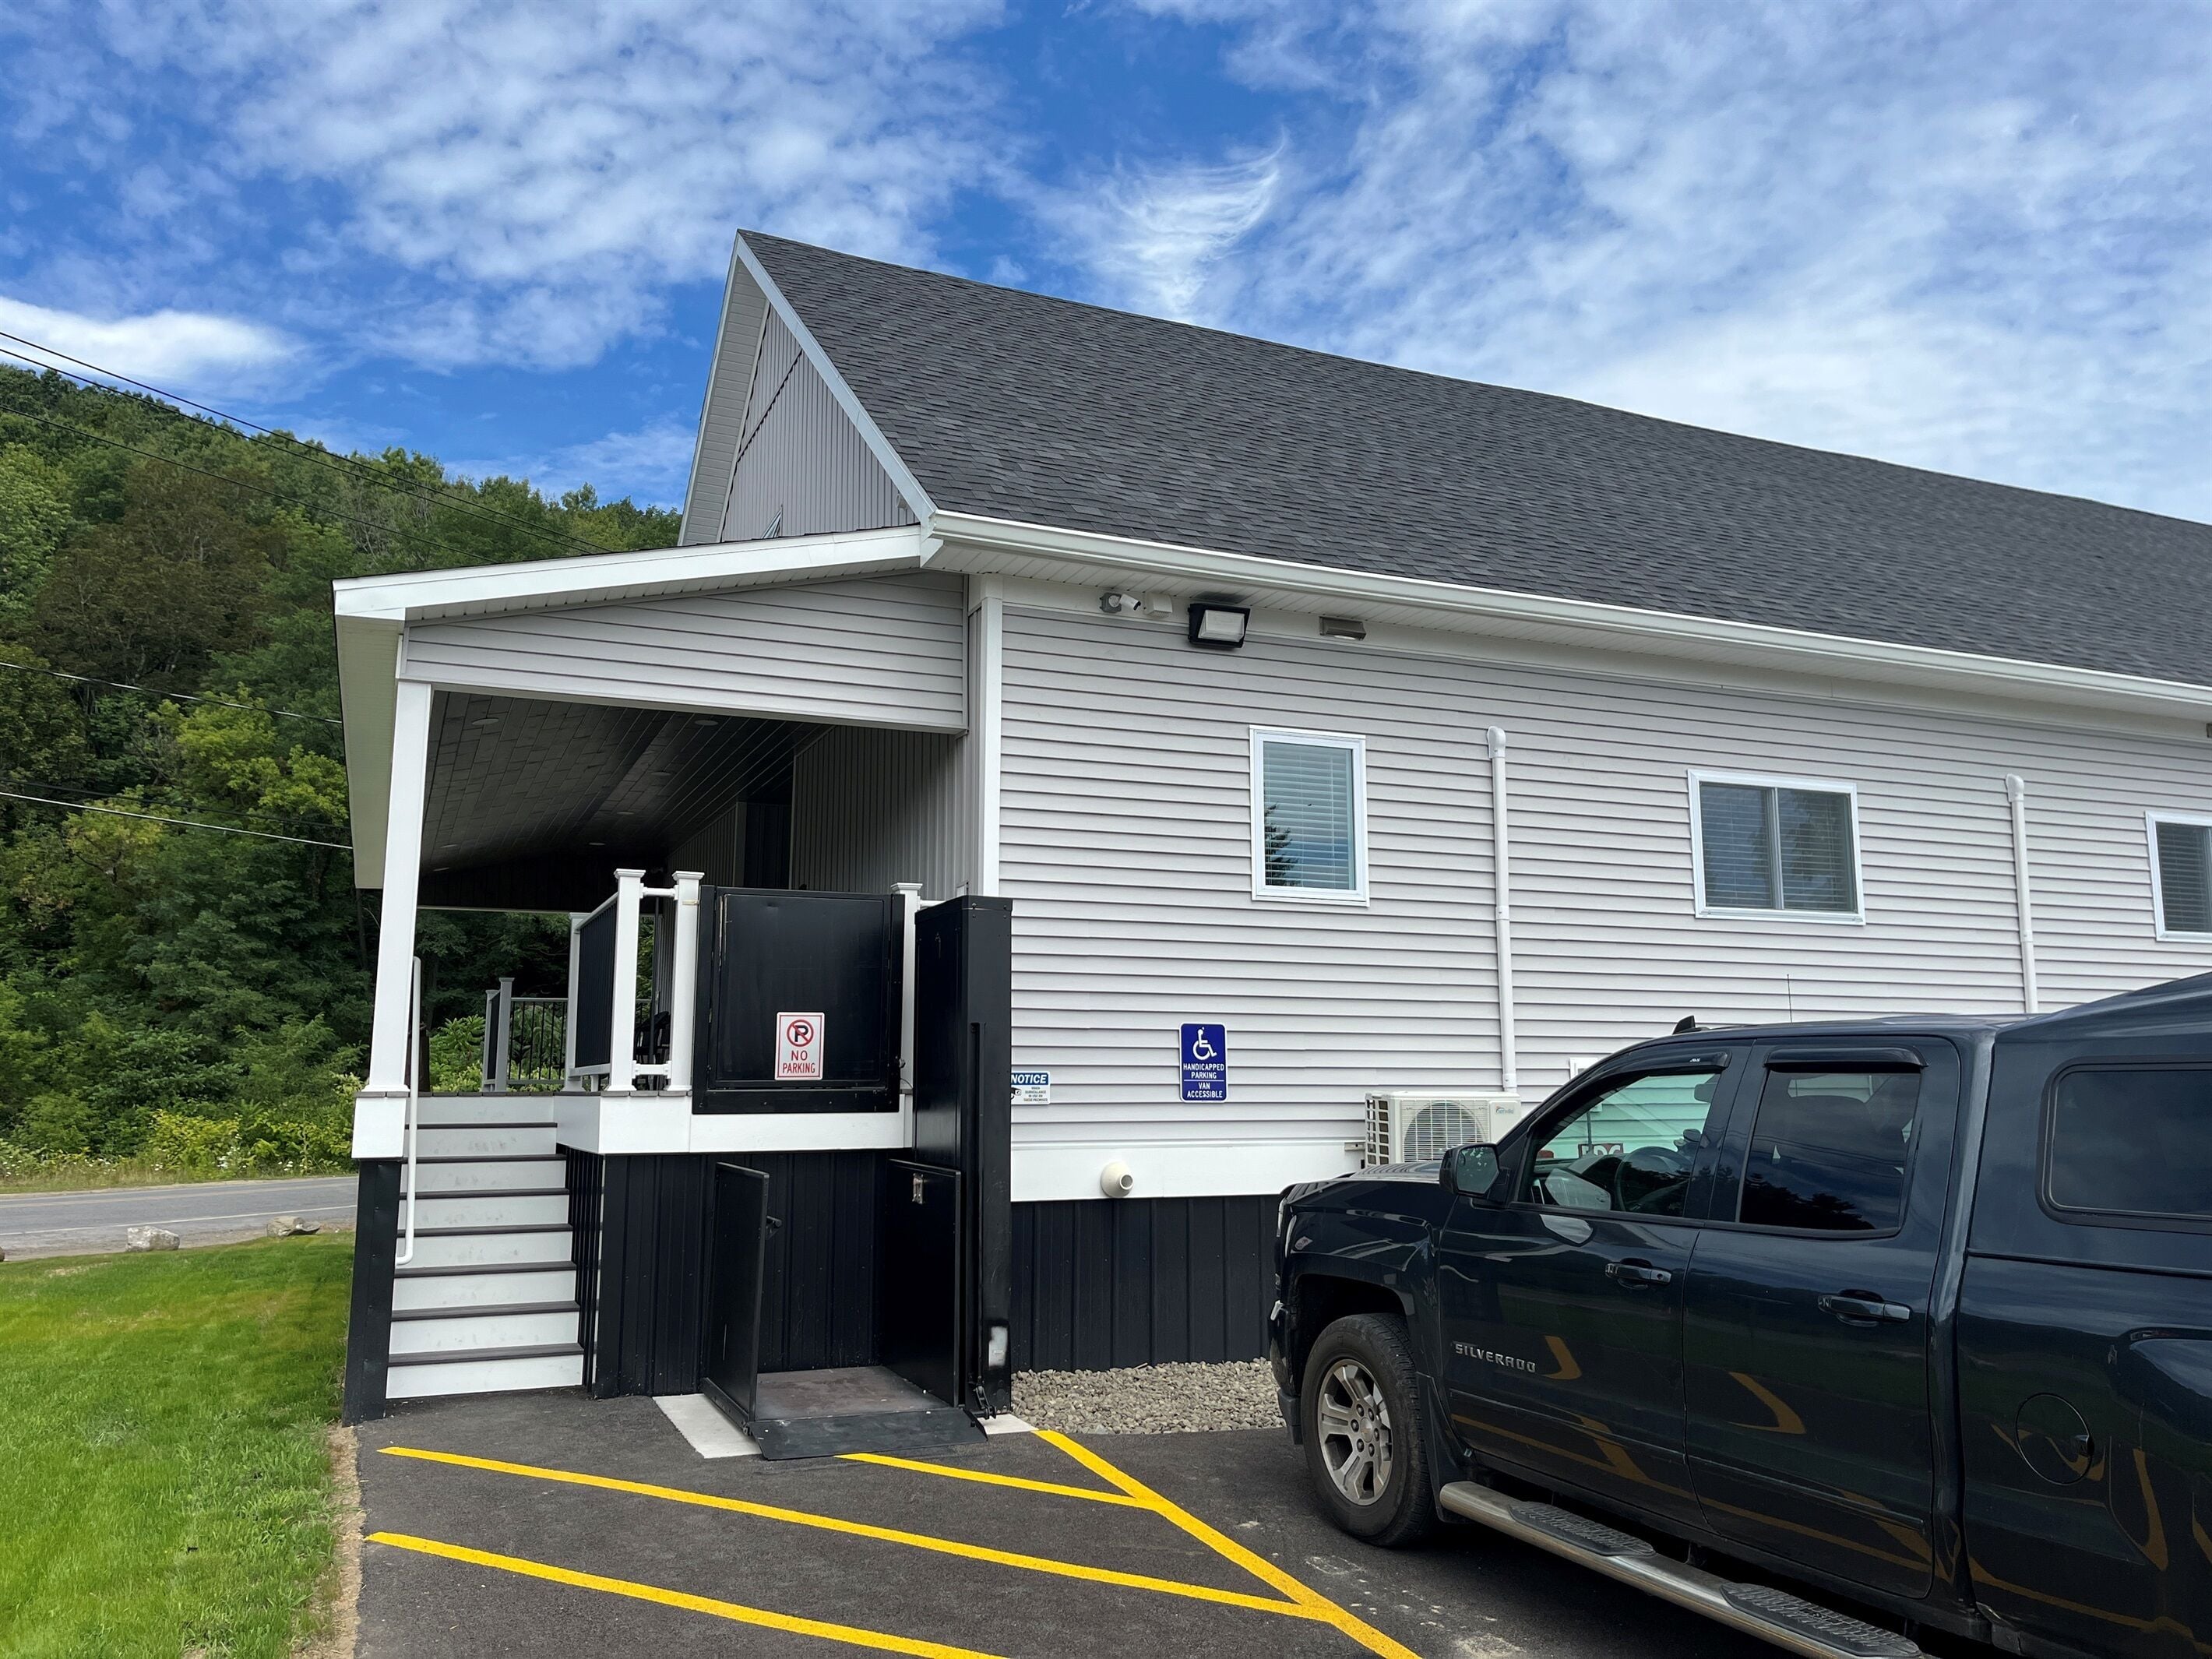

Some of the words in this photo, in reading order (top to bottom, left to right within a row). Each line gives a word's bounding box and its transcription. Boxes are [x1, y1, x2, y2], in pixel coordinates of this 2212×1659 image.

[791, 1050, 808, 1061] NO
[782, 1062, 815, 1074] PARKING
[1011, 1074, 1047, 1083] NOTICE
[1455, 1344, 1536, 1373] SILVERADO
